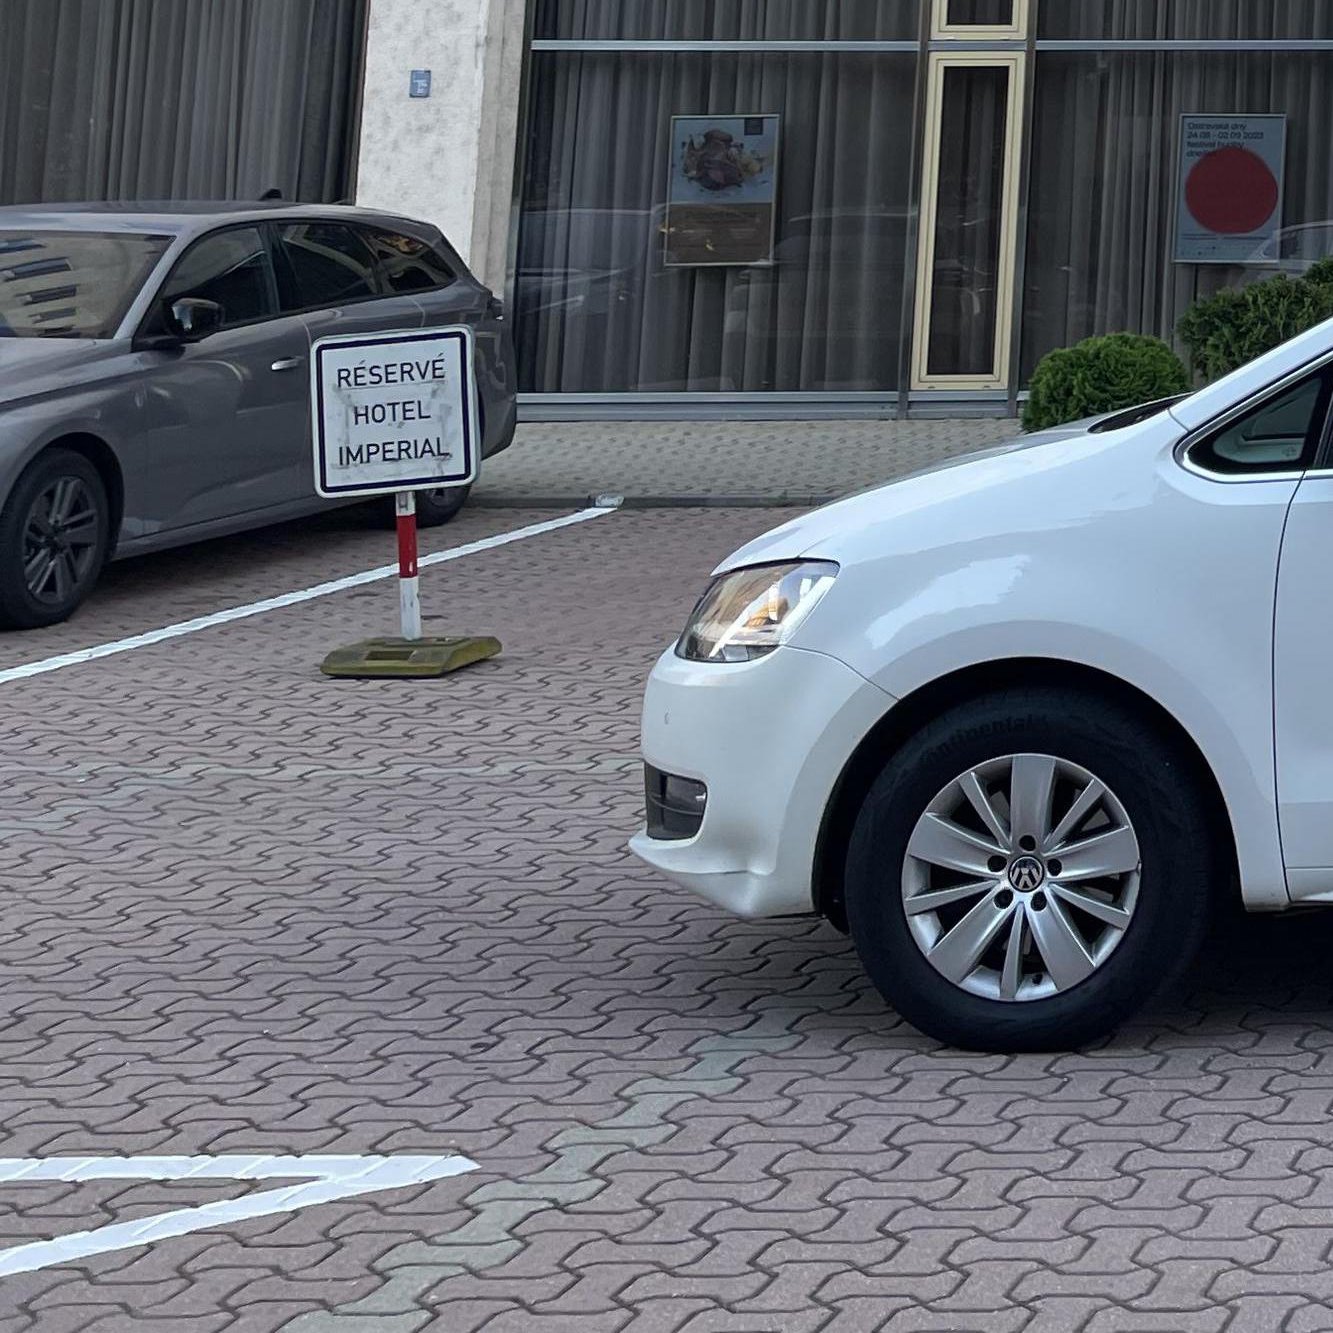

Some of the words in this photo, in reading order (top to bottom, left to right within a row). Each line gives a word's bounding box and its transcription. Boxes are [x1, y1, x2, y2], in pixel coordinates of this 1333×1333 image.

[337, 353, 445, 388] RÉSERVÉ
[354, 400, 431, 426] HOTEL
[339, 437, 450, 466] IMPERIAL
